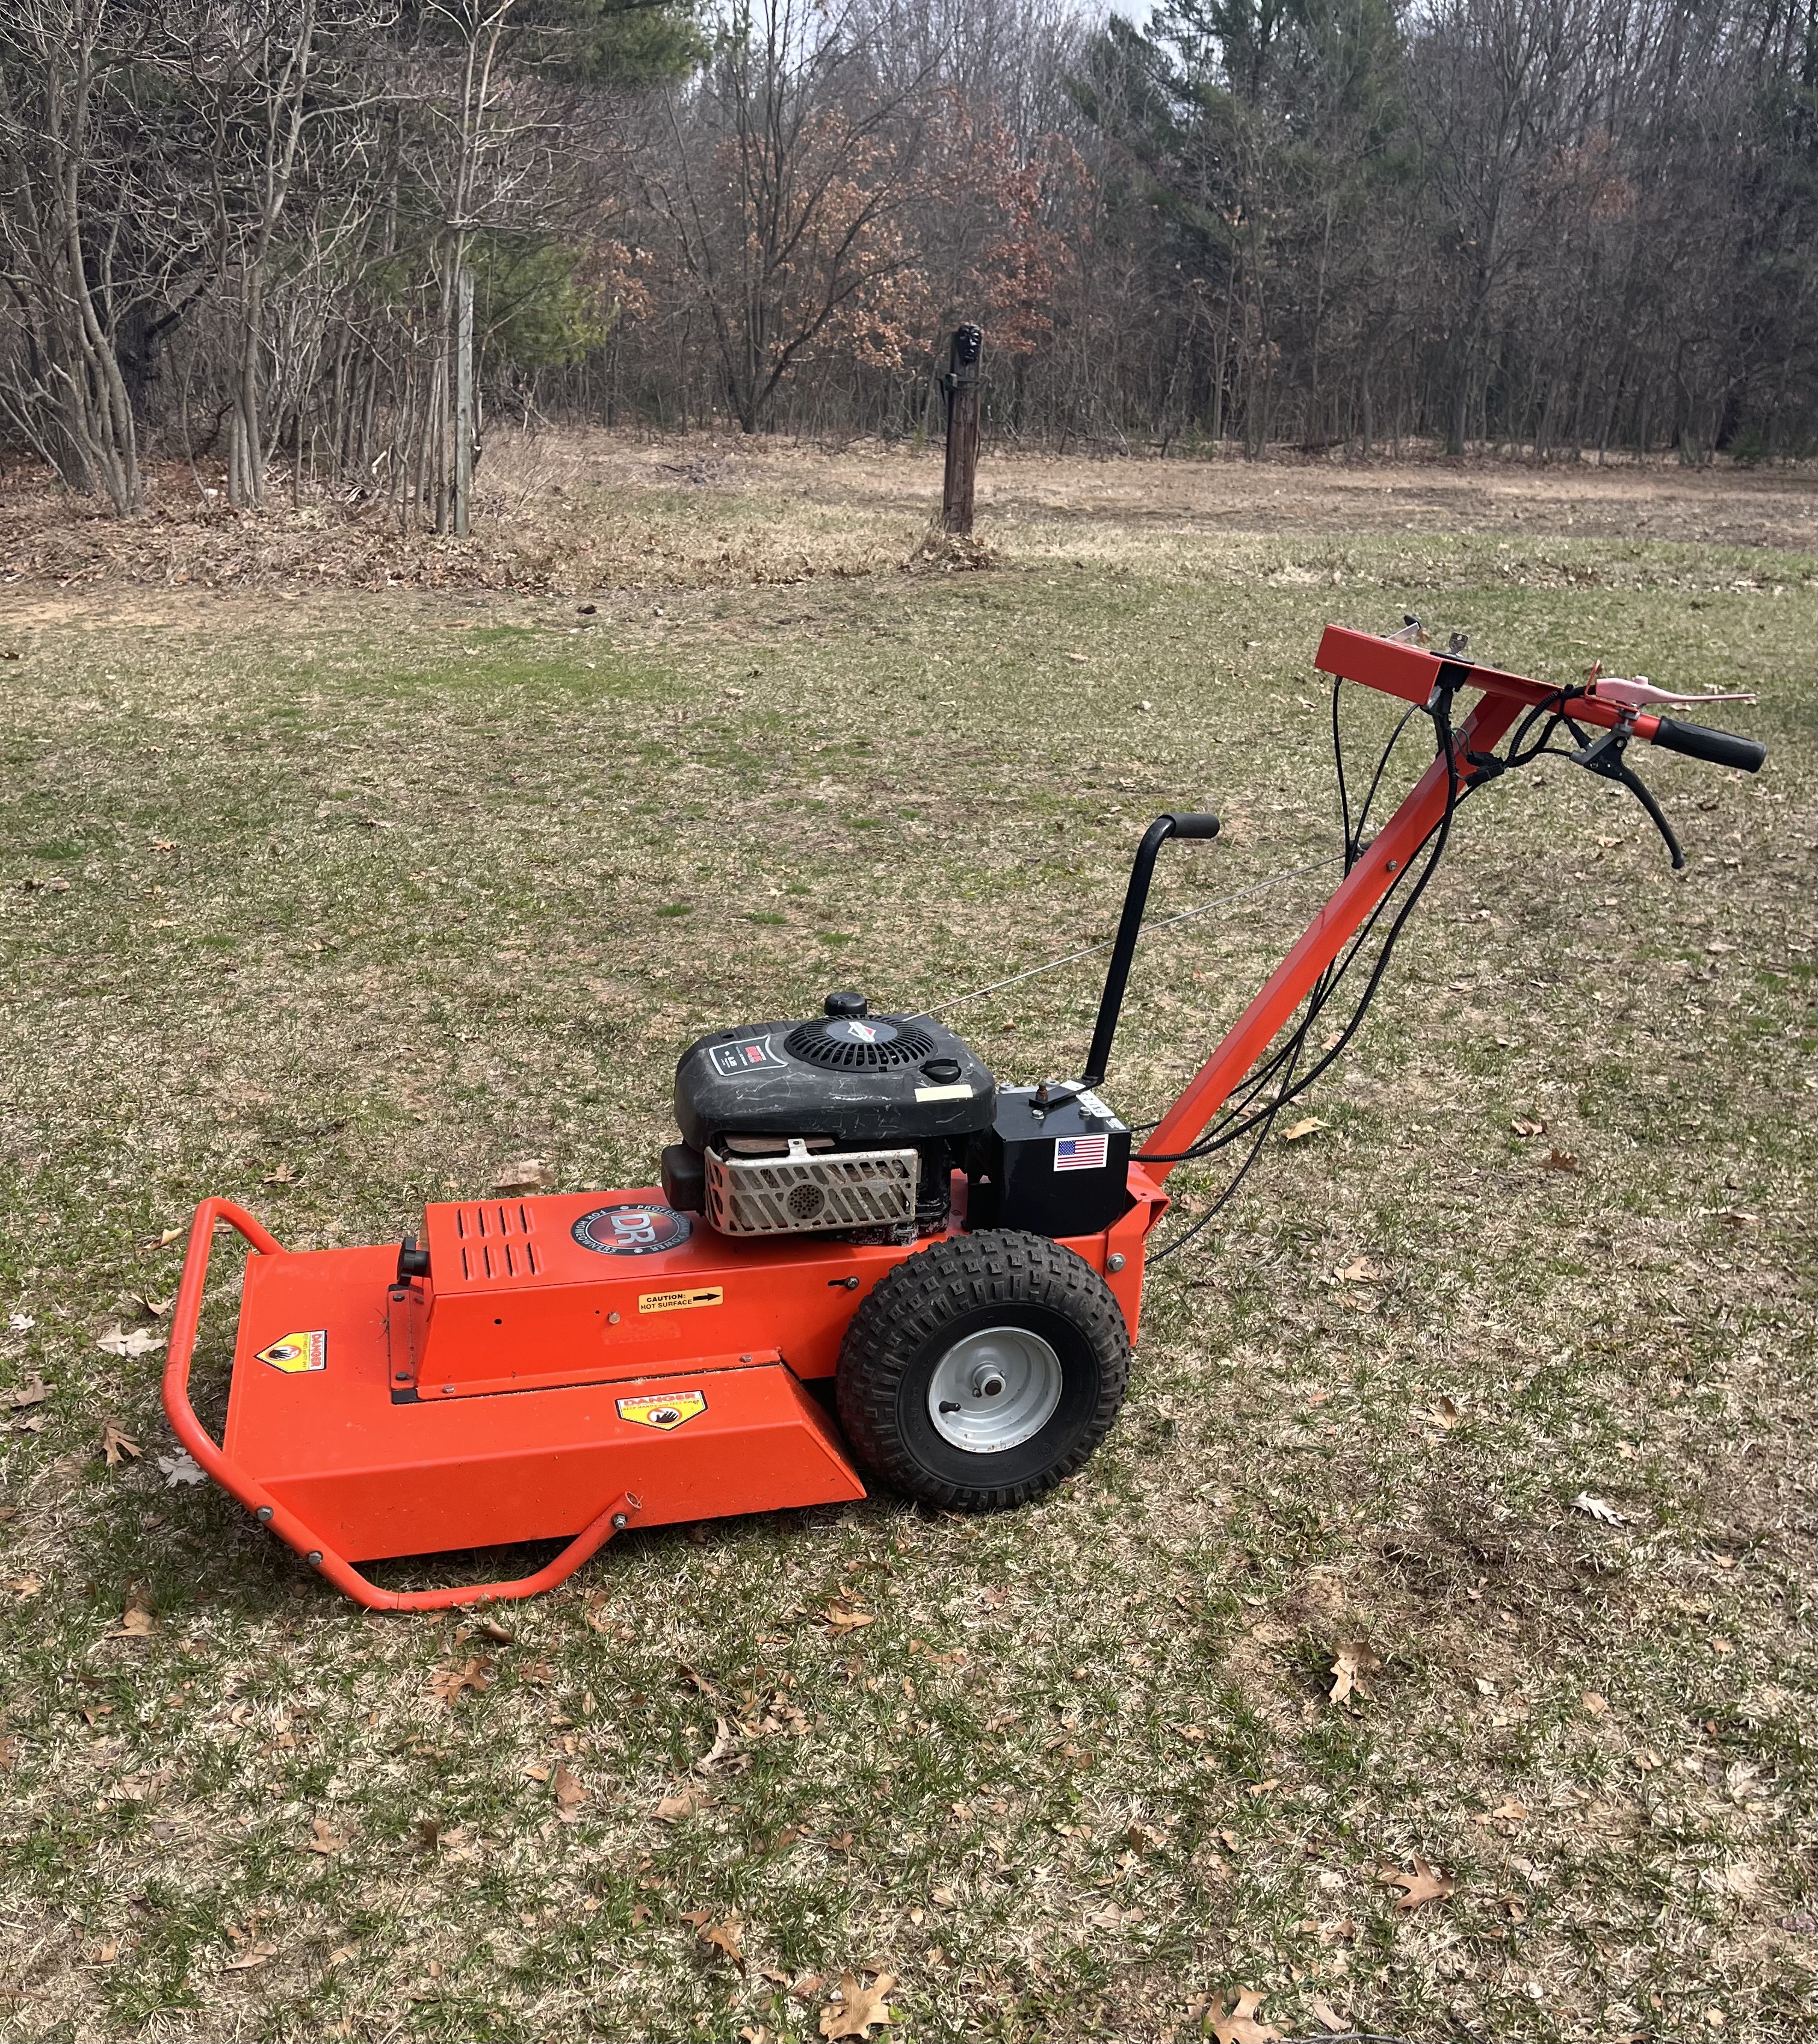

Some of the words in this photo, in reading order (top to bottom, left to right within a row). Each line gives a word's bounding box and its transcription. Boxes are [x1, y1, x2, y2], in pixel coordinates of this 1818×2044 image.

[585, 1209, 607, 1220] FOR
[637, 1205, 689, 1233] PROFESSIONAL
[575, 1220, 618, 1253] HOMEOWNERS
[610, 1213, 657, 1245] DR
[650, 1235, 685, 1252] POWER
[646, 1294, 686, 1303] CAUTION:
[658, 1298, 693, 1308] SURFACE
[311, 1333, 322, 1368] DANGER
[623, 1393, 696, 1406] DANGER
